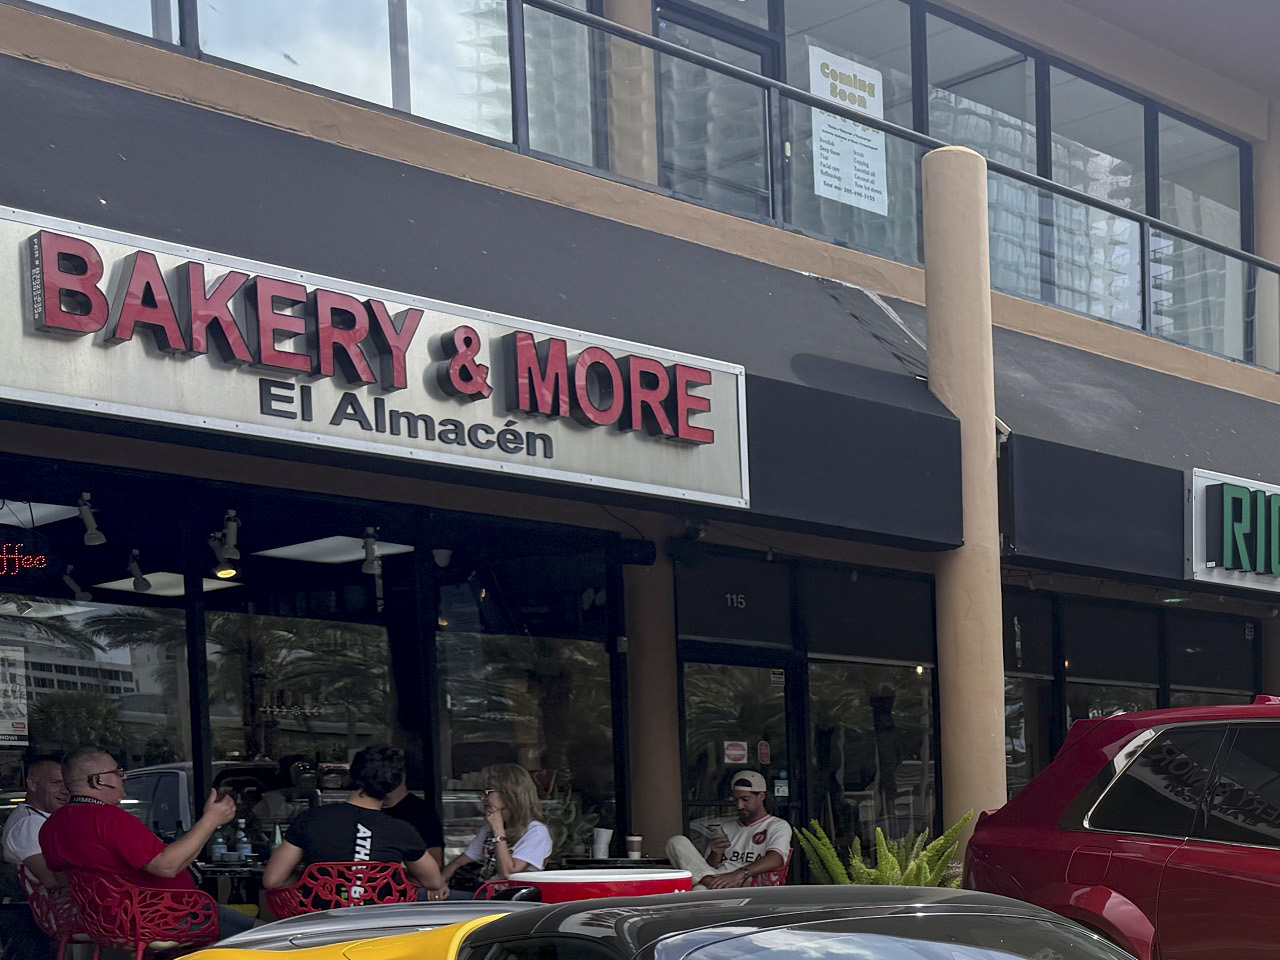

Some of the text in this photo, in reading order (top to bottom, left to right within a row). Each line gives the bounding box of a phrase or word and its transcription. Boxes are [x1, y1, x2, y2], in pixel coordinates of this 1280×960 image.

[820, 62, 876, 98] Coming
[829, 82, 867, 109] Soon
[39, 229, 714, 444] BAKERY & MORE
[259, 378, 554, 459] El Almacén
[0, 543, 47, 575] ffee
[725, 593, 746, 609] 115
[353, 823, 373, 862] ATH
